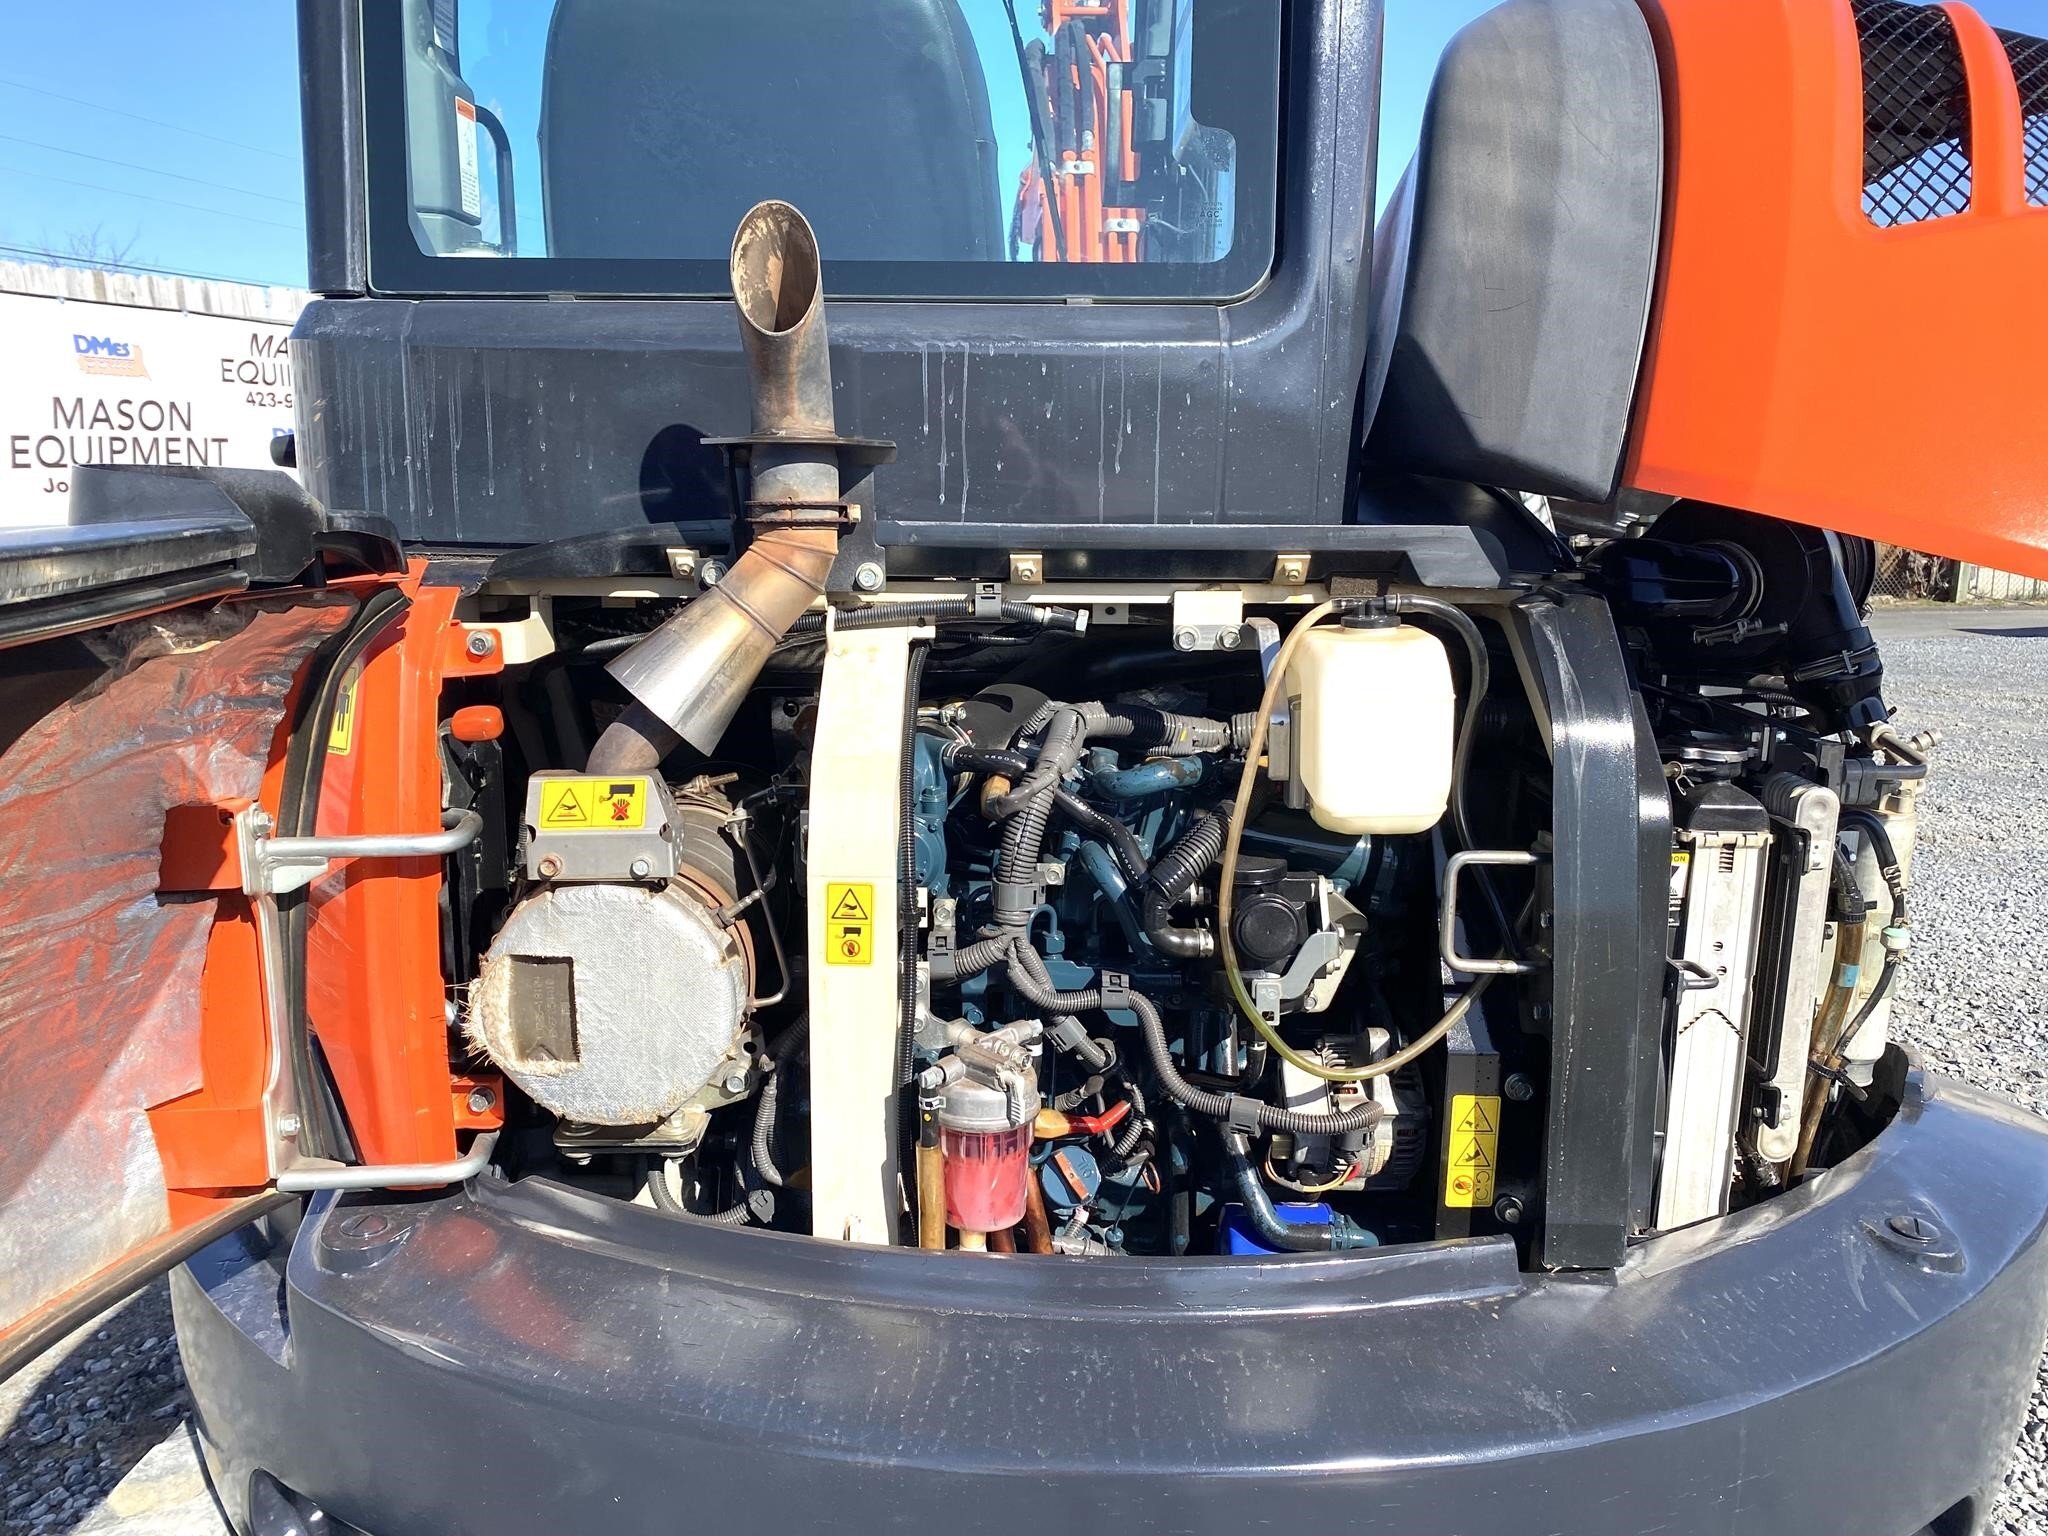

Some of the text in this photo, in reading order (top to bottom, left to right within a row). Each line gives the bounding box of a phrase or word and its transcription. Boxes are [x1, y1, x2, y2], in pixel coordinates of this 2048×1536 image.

[52, 397, 192, 432] MASON
[10, 435, 229, 469] EQUIPMENT
[43, 478, 69, 493] Jo
